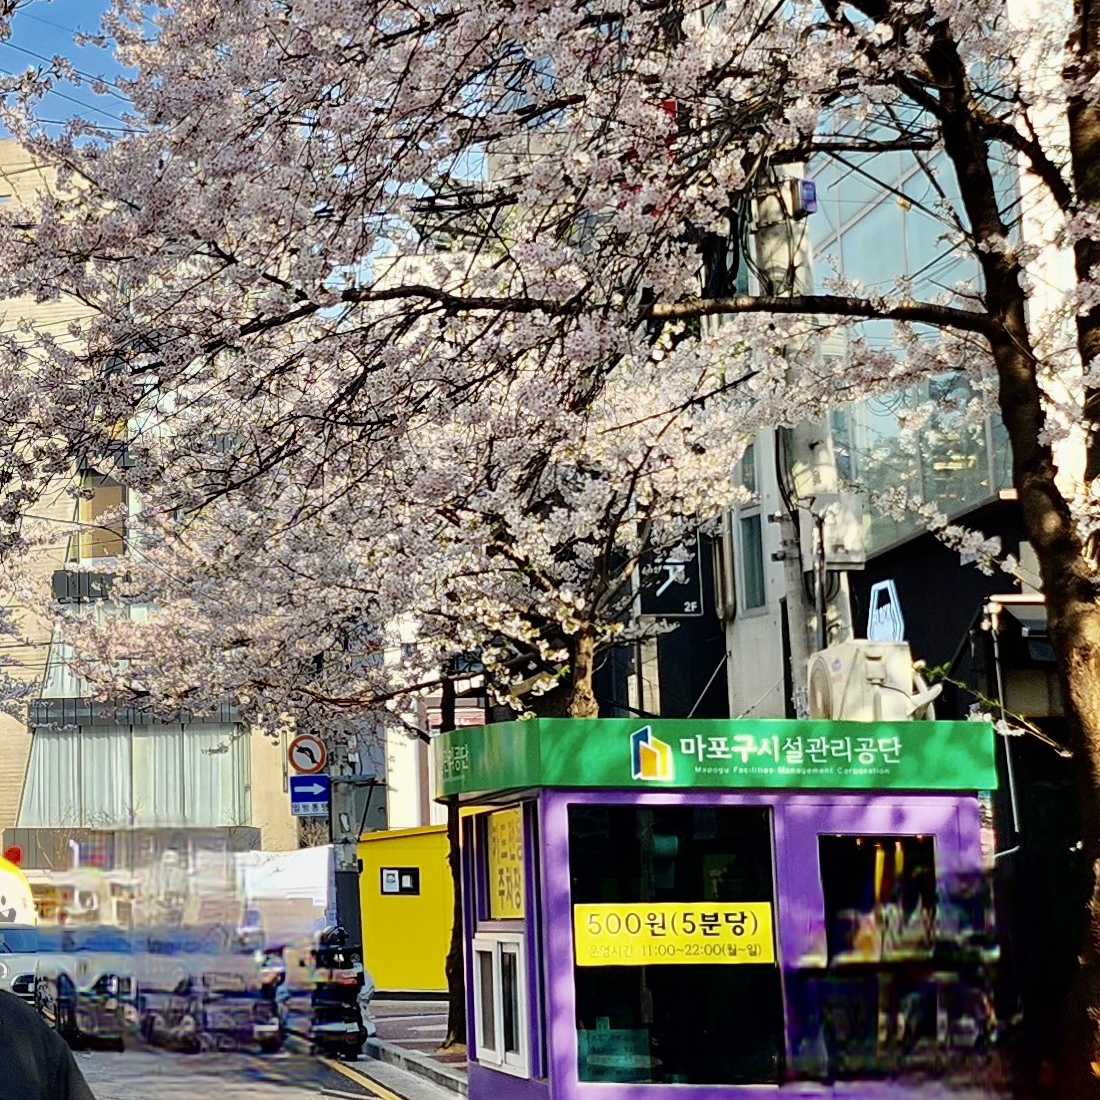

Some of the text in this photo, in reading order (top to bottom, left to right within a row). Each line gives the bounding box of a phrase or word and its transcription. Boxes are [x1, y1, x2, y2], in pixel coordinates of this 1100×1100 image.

[684, 601, 698, 612] 2F
[679, 733, 902, 764] 마포구시설관리공단
[694, 765, 891, 775] Mapogu Facilities Management Corporation
[498, 866, 521, 910] 주차장
[588, 911, 758, 937] 500원(5분당)
[589, 943, 762, 958] 운영시간 11:00~22:00(월~일)
